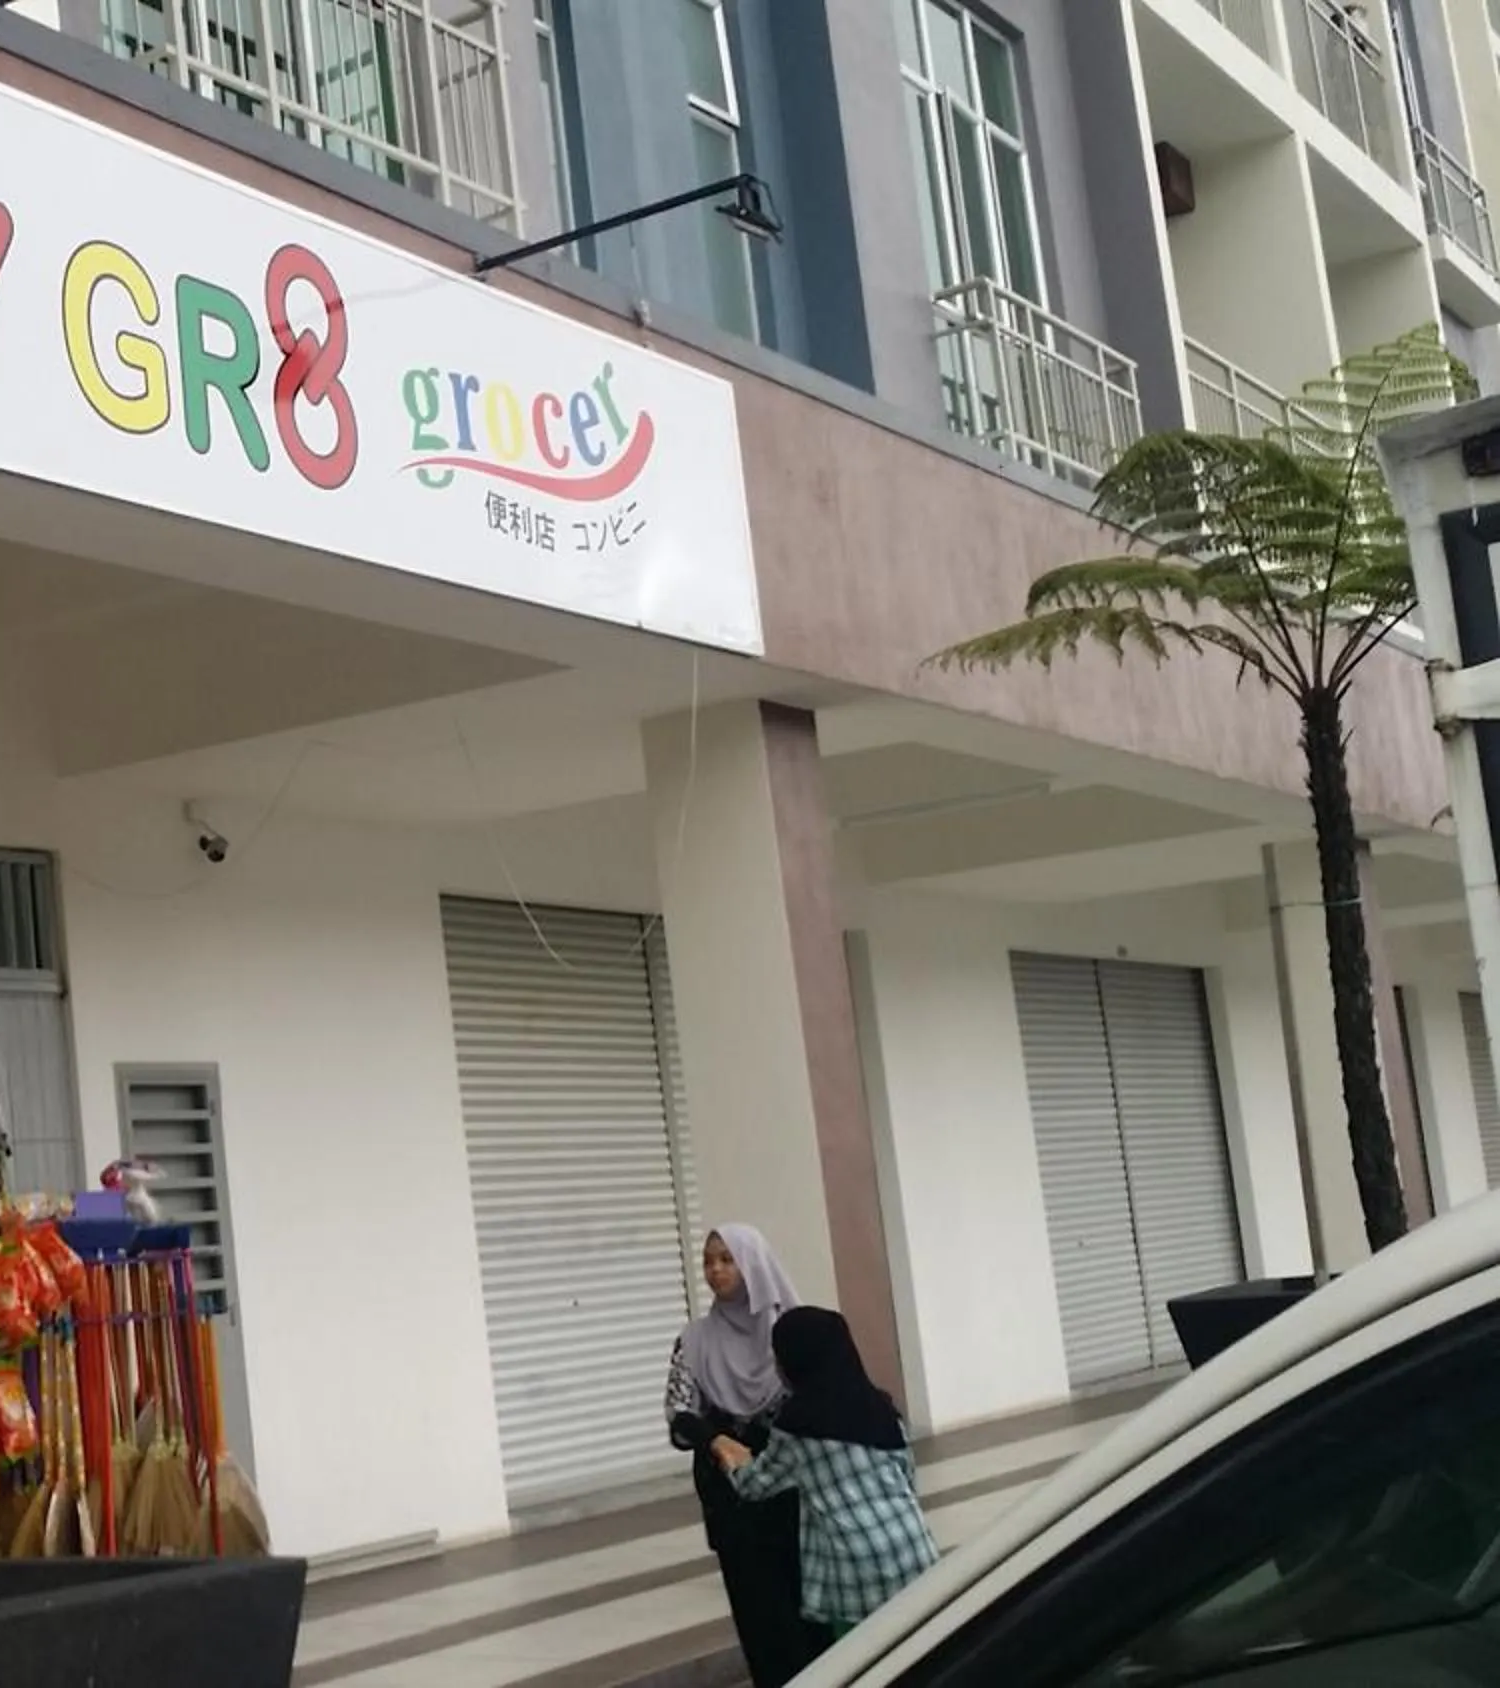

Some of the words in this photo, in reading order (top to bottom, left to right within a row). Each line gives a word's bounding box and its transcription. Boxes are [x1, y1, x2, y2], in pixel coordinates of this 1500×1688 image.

[62, 240, 359, 490] GR8
[402, 361, 630, 489] grocer
[484, 490, 556, 552] 便利店
[571, 501, 647, 552] コンビニ
